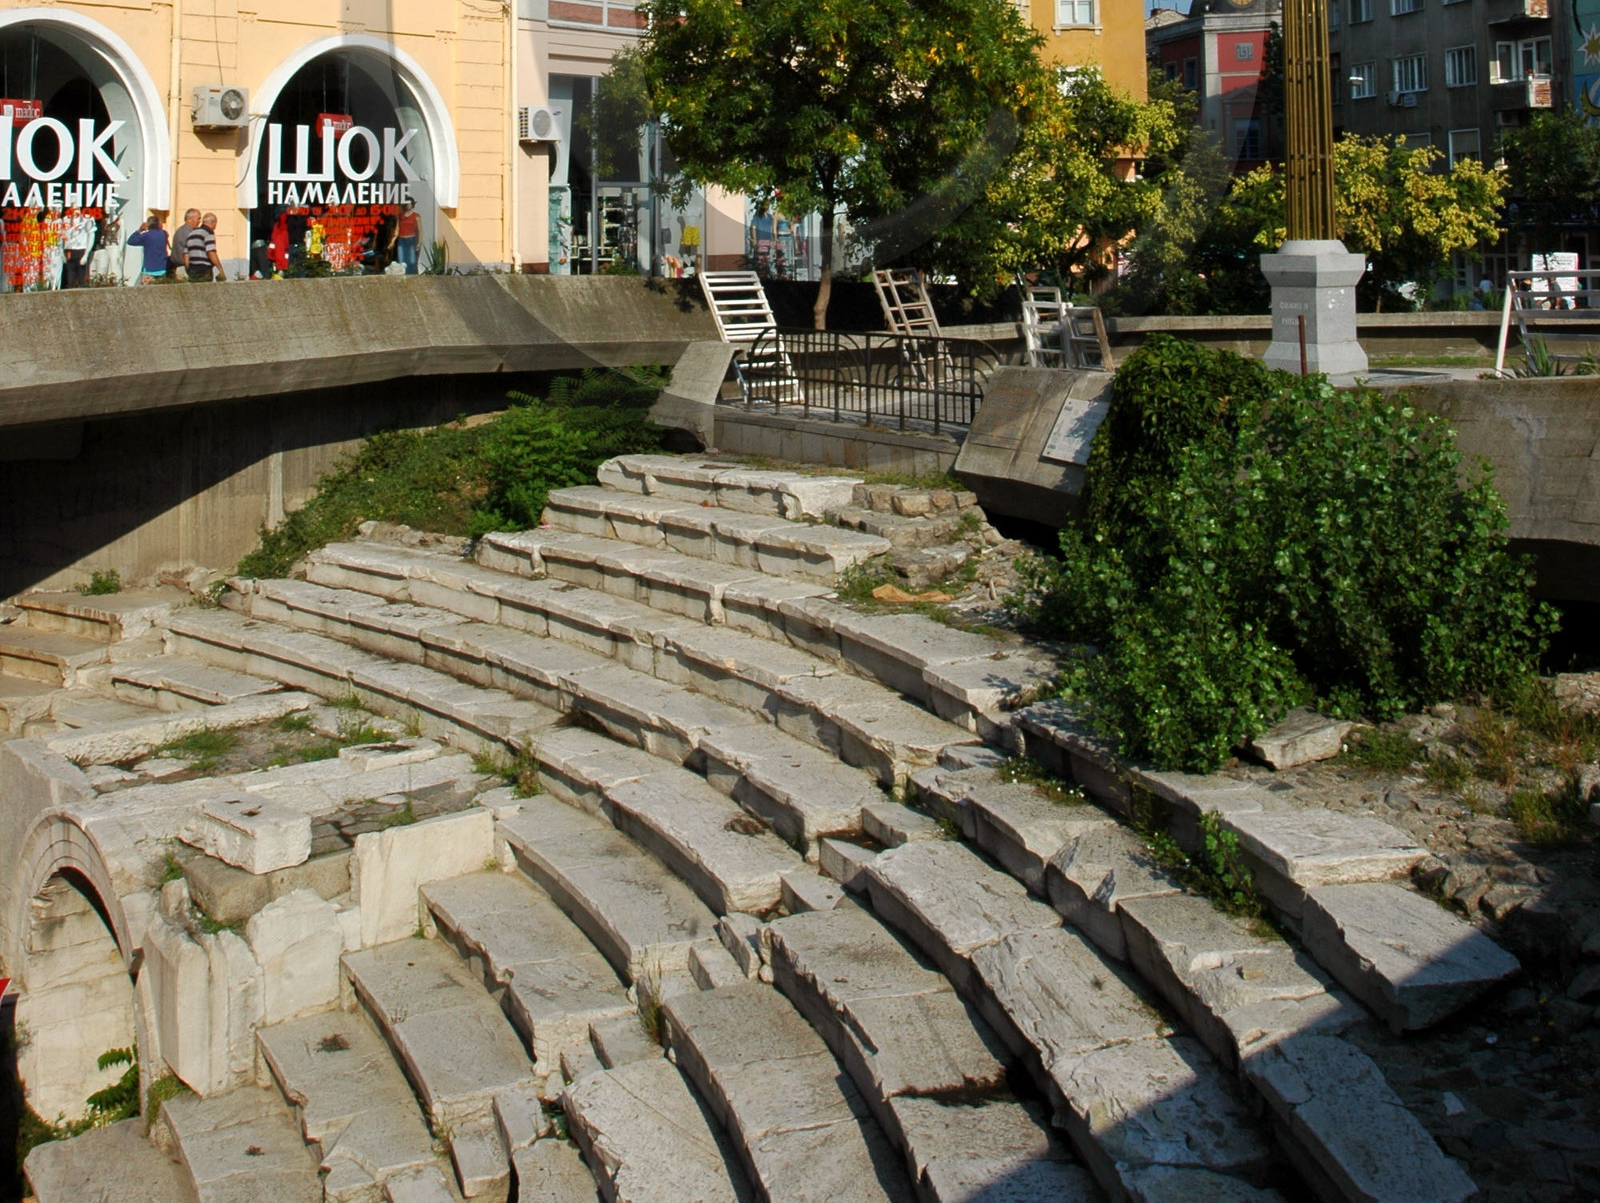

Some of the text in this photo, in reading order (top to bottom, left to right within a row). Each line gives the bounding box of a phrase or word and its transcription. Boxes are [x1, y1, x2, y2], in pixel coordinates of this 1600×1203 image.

[0, 115, 127, 181] ОК
[268, 123, 421, 181] ШОК
[268, 182, 412, 204] НАМАЛЕНИЕ
